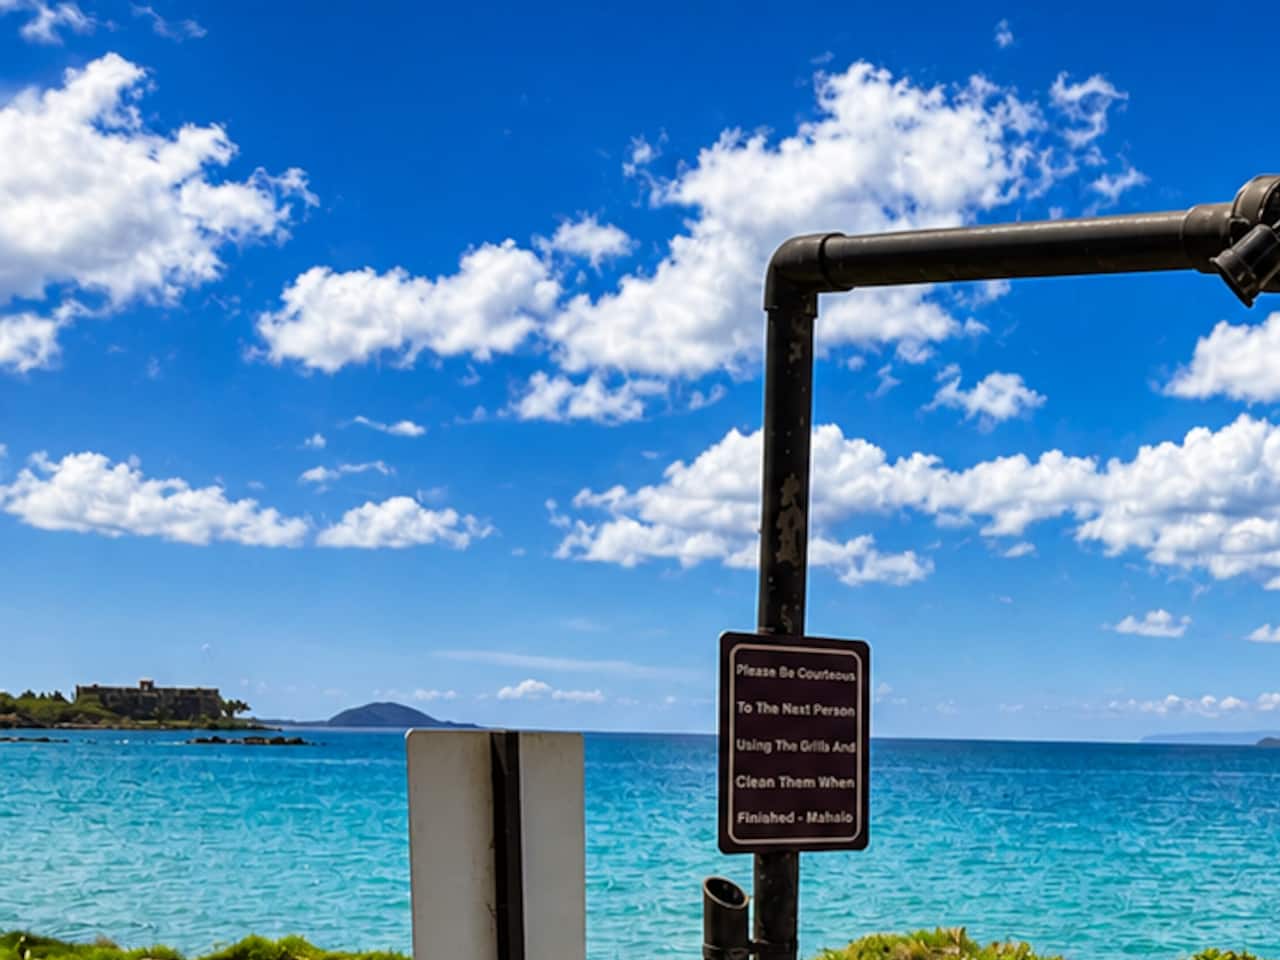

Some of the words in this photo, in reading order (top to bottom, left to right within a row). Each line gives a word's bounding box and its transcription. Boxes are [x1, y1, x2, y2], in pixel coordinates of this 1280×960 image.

[736, 664, 777, 677] Please
[779, 666, 795, 678] Be
[797, 667, 856, 681] Courteous
[738, 701, 753, 714] To
[756, 701, 779, 714] The
[782, 702, 811, 715] Next
[813, 703, 855, 717] Person
[736, 739, 772, 754] Using
[775, 740, 799, 752] The
[800, 740, 830, 752] Grills
[832, 741, 856, 753] And
[736, 775, 775, 788] Clean
[778, 776, 816, 788] Them
[818, 776, 855, 789] When
[738, 811, 795, 824] Finished
[806, 811, 854, 823] Mahalo
